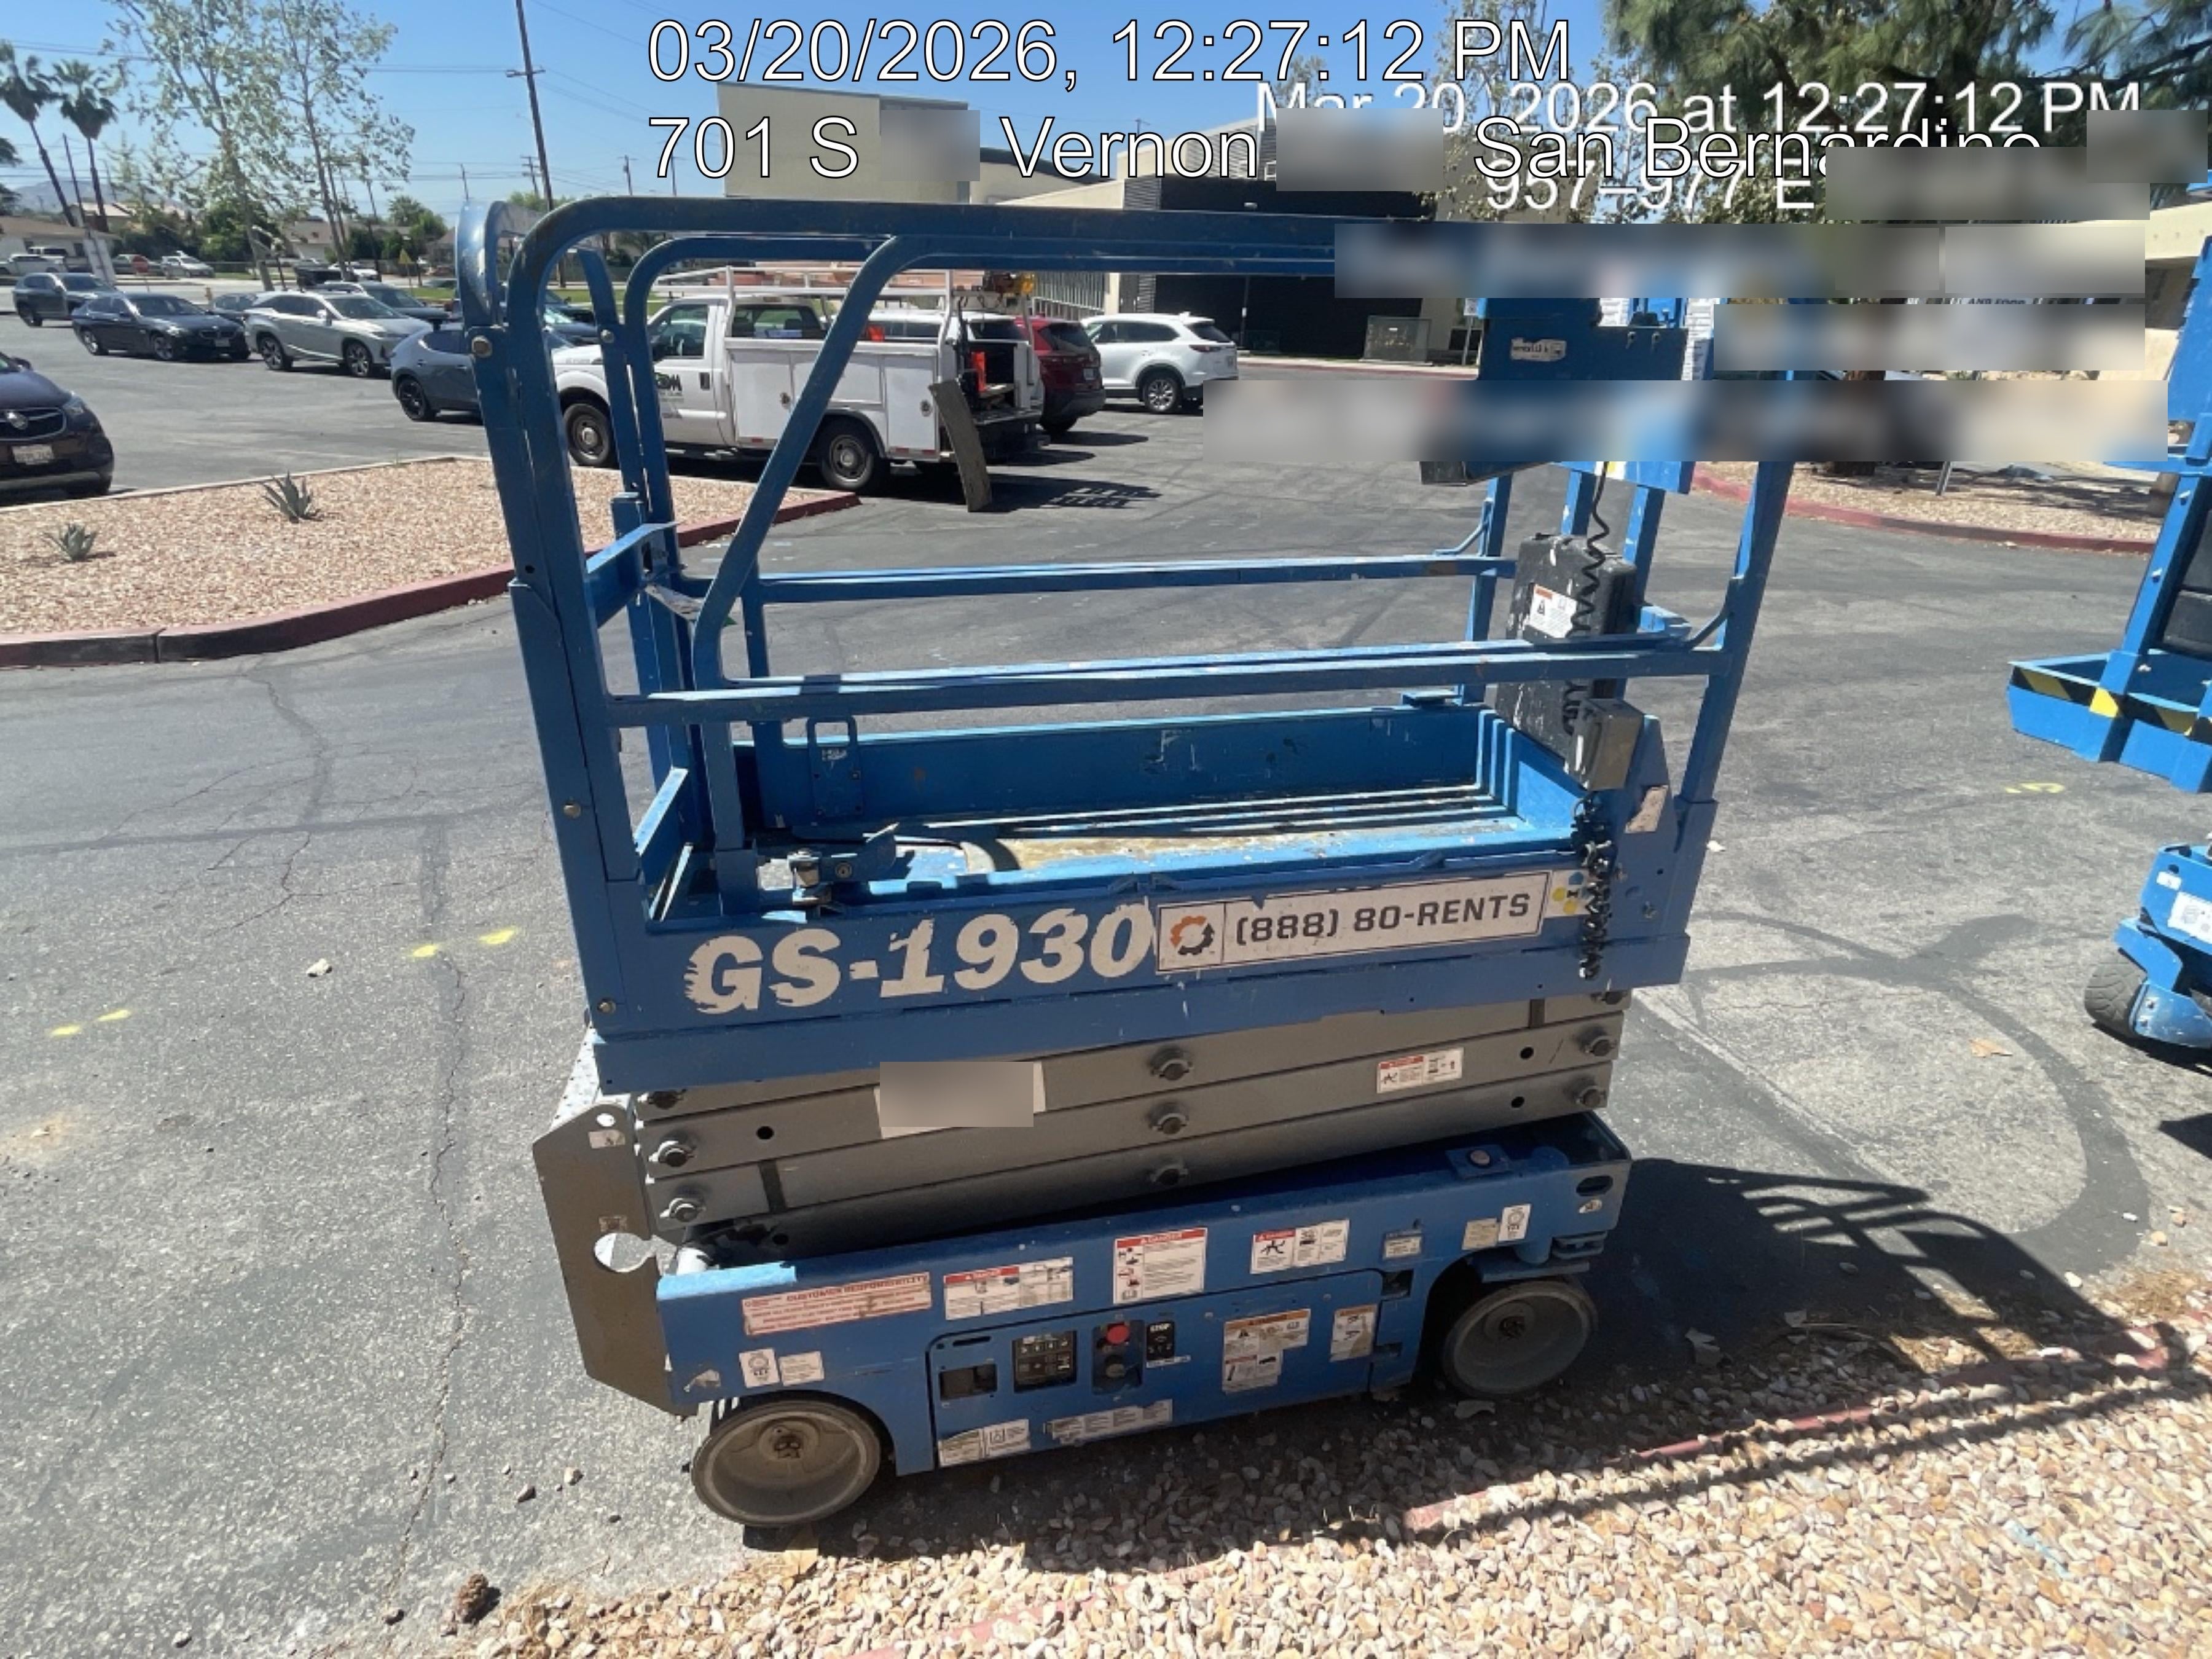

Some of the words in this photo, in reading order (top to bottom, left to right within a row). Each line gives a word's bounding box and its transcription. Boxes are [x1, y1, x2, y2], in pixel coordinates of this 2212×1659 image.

[684, 897, 1156, 1014] GS-1930
[1236, 909, 1339, 946] (888)
[1354, 893, 1531, 931] 80-RENTS
